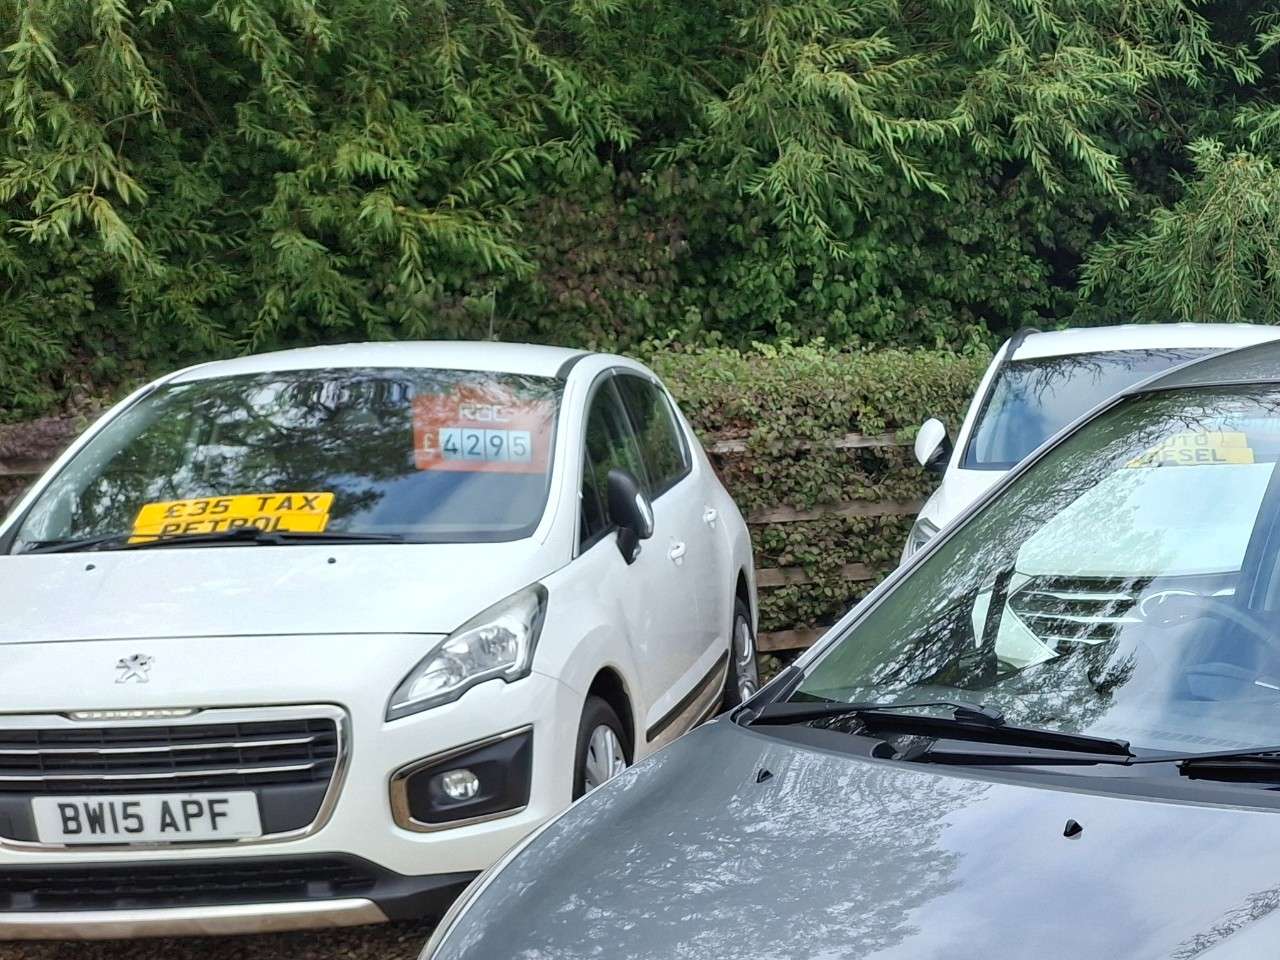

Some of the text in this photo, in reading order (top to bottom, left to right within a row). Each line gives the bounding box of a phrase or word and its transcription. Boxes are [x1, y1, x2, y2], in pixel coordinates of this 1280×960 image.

[164, 496, 319, 518] £35 TAX
[57, 799, 229, 834] BW15 APF
